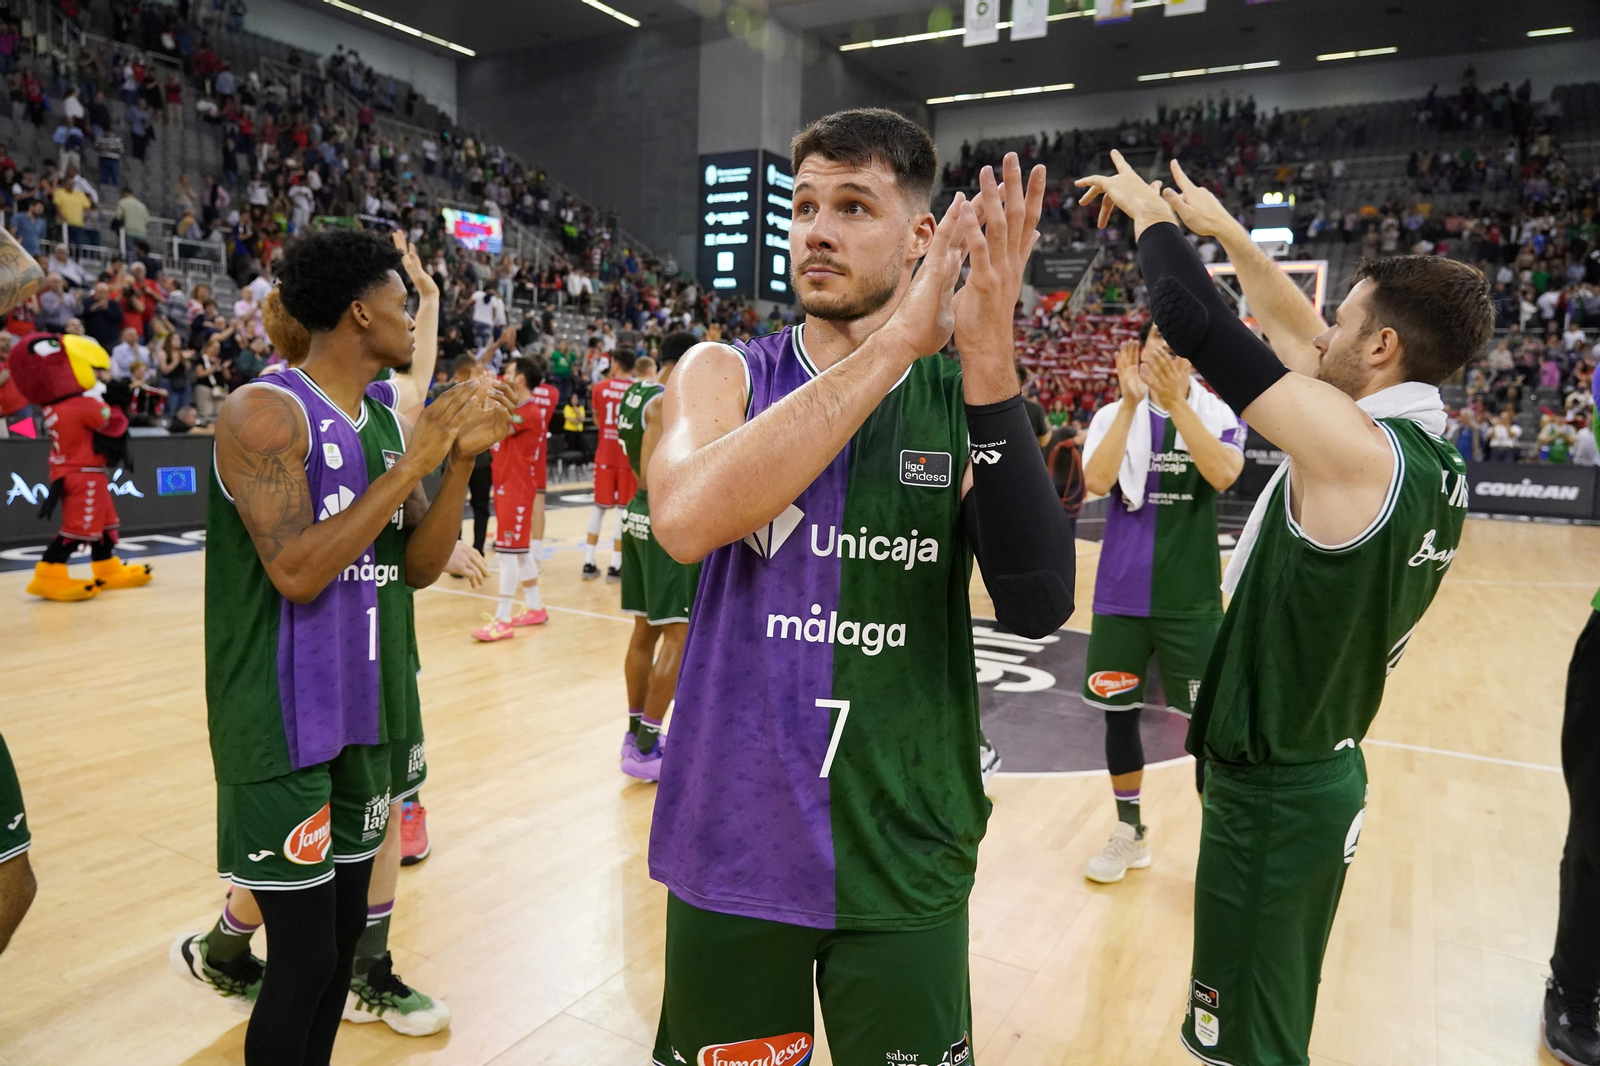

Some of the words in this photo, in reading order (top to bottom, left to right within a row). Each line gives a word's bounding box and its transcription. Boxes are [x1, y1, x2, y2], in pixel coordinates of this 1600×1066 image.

[905, 461, 924, 472] liga
[905, 472, 947, 482] endesa
[811, 524, 939, 570] Unicaja
[366, 607, 376, 661] 1
[815, 698, 850, 778] 7
[1196, 989, 1212, 1003] acb
[886, 1050, 919, 1062] sabor
